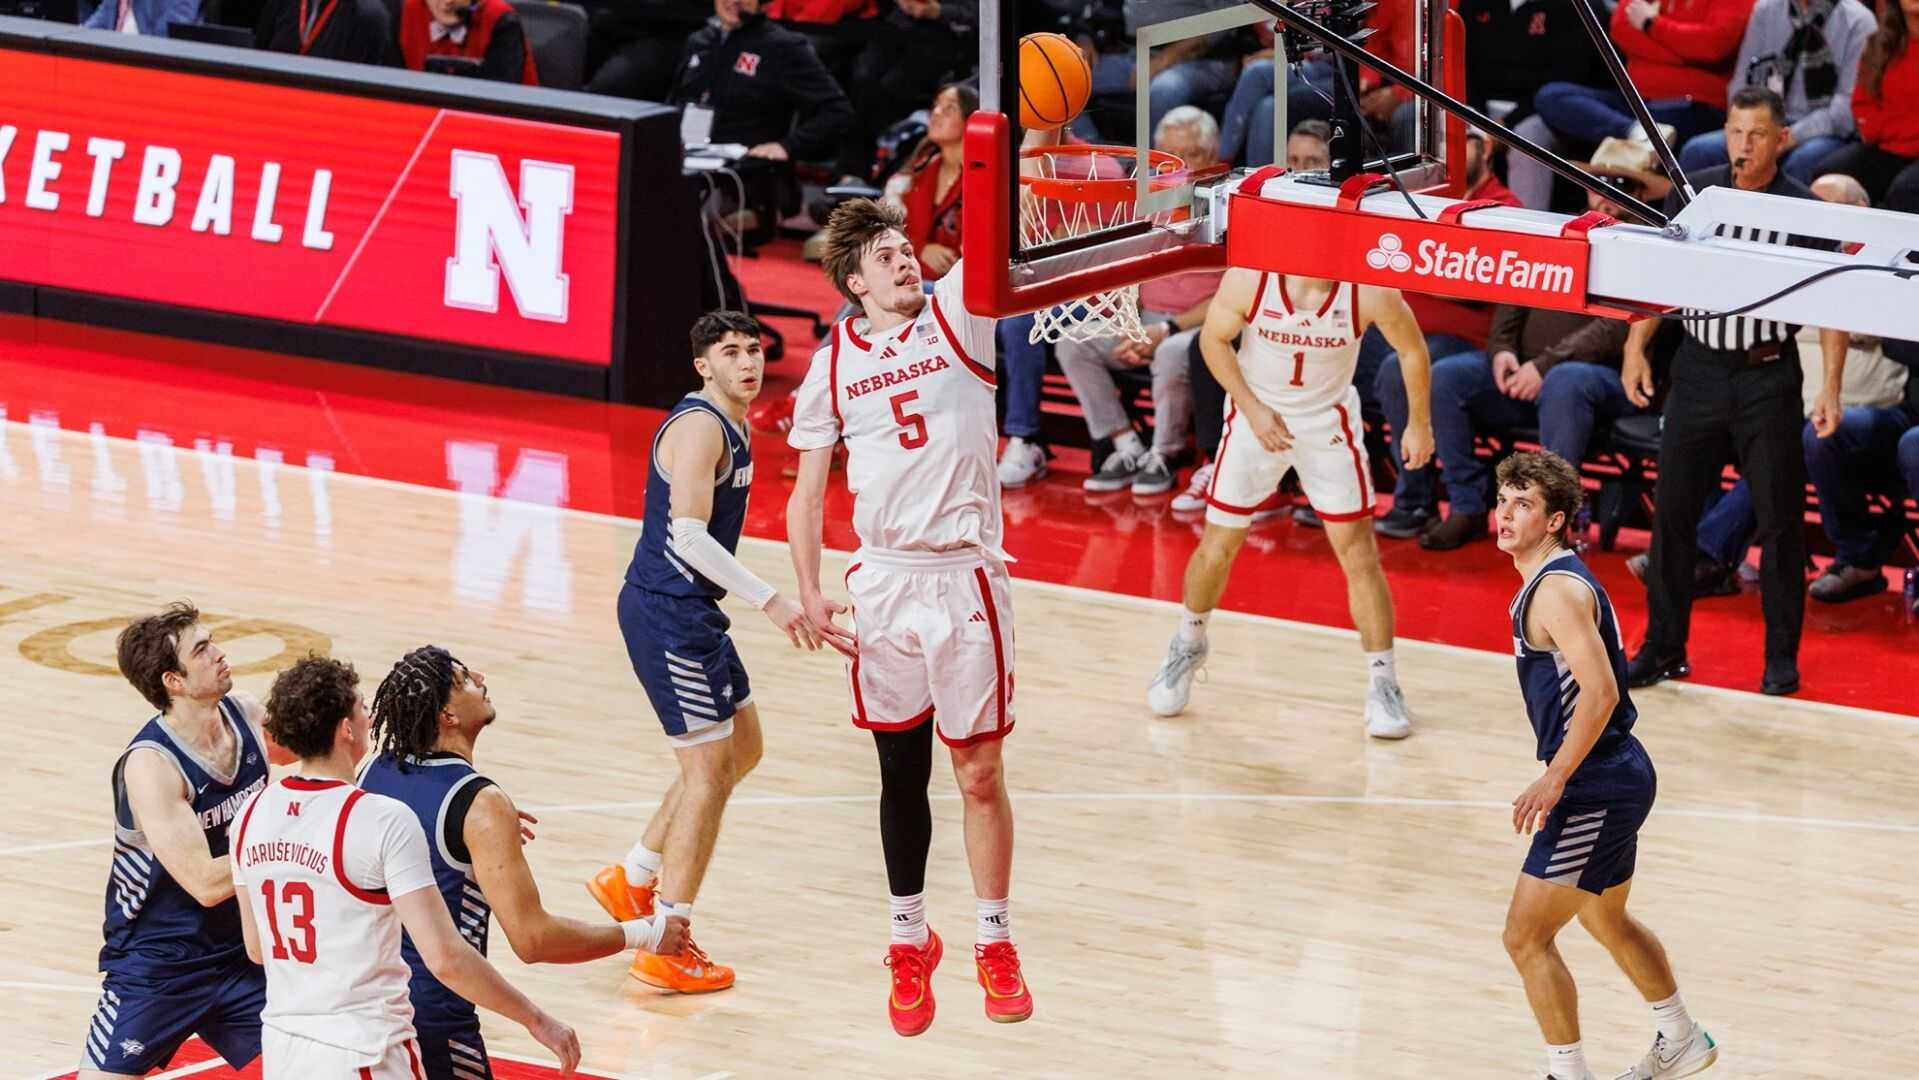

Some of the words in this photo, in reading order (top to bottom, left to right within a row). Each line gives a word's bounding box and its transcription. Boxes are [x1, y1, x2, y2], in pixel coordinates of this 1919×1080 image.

[444, 148, 576, 324] N
[1258, 327, 1347, 348] NEBRASKA
[845, 355, 950, 400] NEBRASKA
[1289, 351, 1305, 387] 1
[889, 390, 929, 450] 5
[286, 801, 301, 817] N
[261, 879, 317, 965] 13
